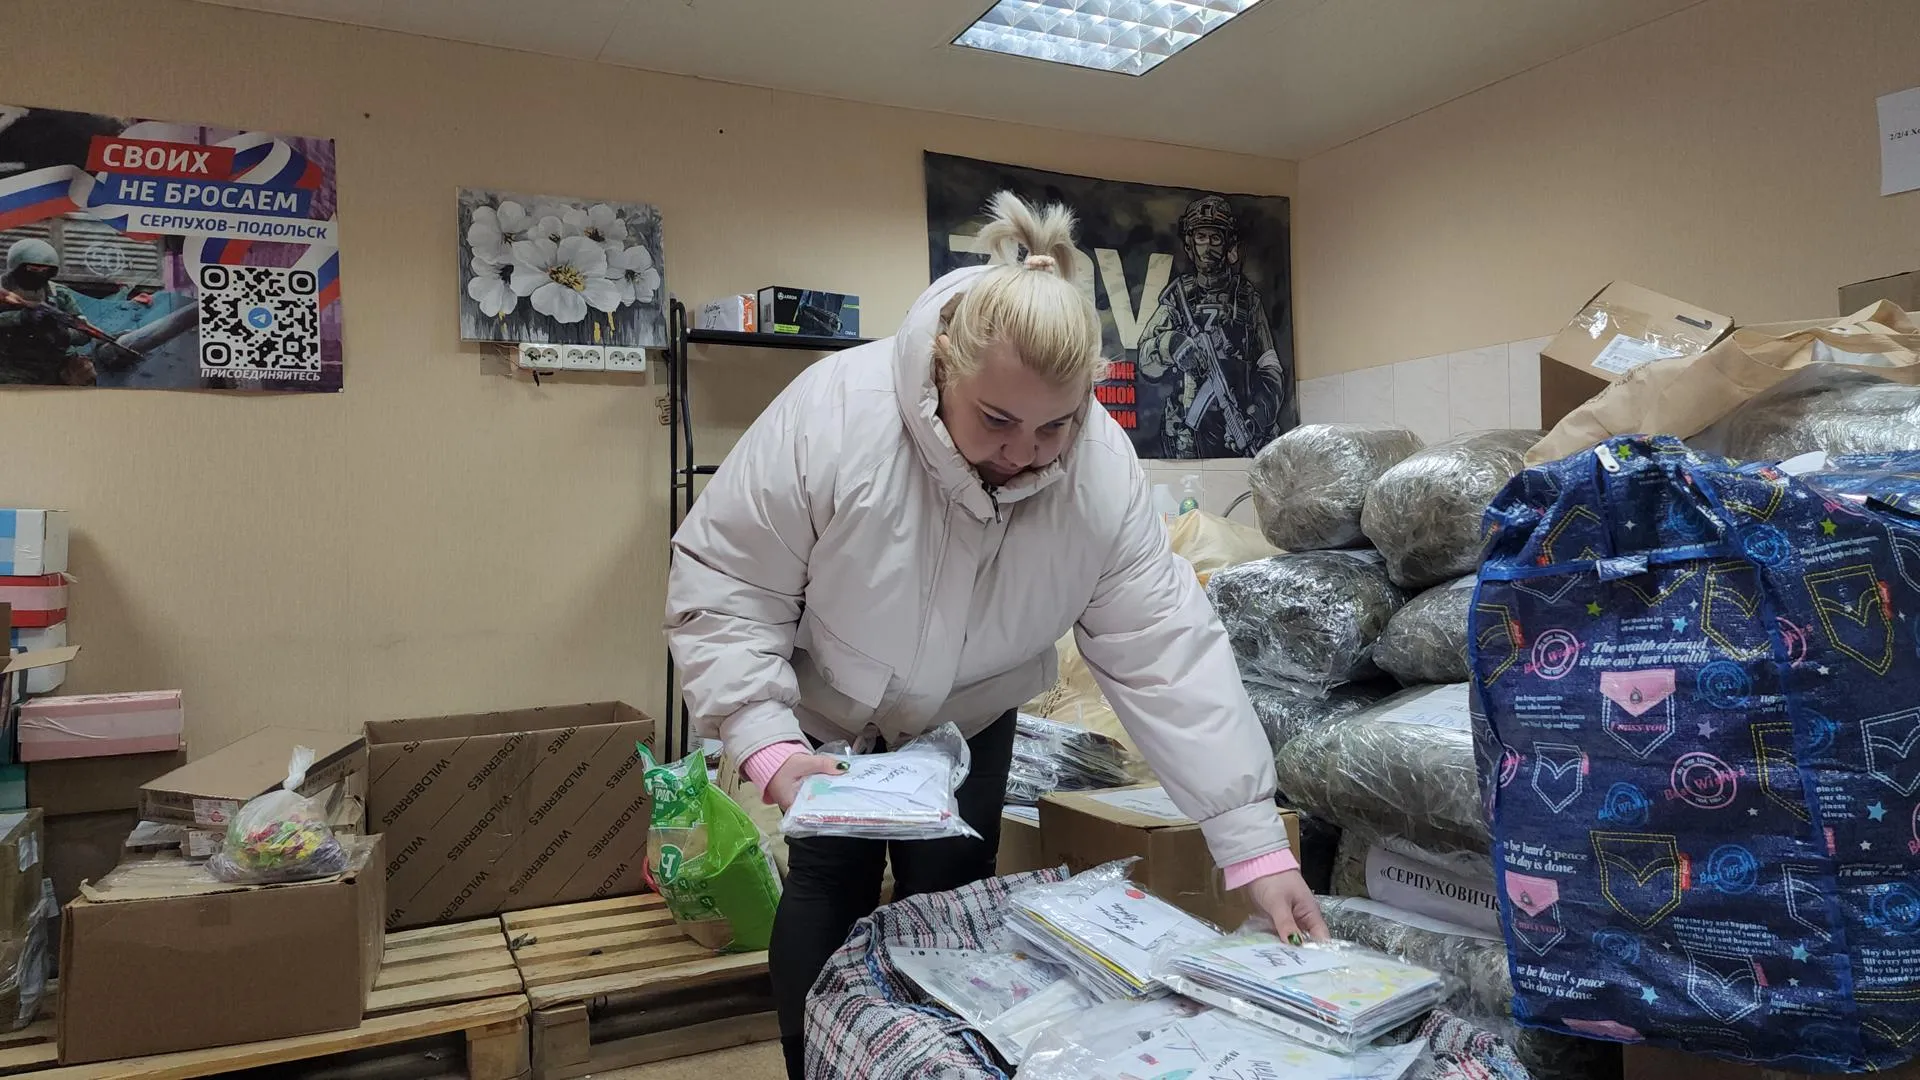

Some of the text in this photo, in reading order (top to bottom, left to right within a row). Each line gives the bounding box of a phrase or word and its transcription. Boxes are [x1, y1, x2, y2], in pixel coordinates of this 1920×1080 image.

[102, 143, 211, 174] СВОИХ
[118, 179, 298, 213] НЕ БРОСАЕМ
[140, 213, 328, 239] СЕРПУХОВ-ПОДОЛЬСК
[1591, 641, 1617, 653] The
[1618, 639, 1656, 653] wealth
[1579, 656, 1590, 666] is
[1590, 654, 1612, 666] the
[1612, 653, 1637, 669] only
[382, 758, 451, 826] WILDBERRIES
[528, 760, 591, 826] WILDBERRIES
[448, 793, 513, 862] WILDBERRIES
[586, 795, 648, 860] WILDBERRIES
[508, 828, 573, 896] WILDBERRIES
[1510, 840, 1521, 852] be
[1522, 841, 1552, 858] heart's
[1554, 850, 1588, 861] peace
[1517, 855, 1533, 870] day
[1533, 858, 1543, 870] is
[1861, 948, 1880, 957] May
[1898, 949, 1910, 957] joy
[1526, 965, 1538, 977] be
[1539, 967, 1576, 984] heart's
[1576, 977, 1606, 988] peace
[1864, 966, 1883, 974] May
[1900, 966, 1913, 974] joy
[1536, 980, 1554, 996] day
[1556, 985, 1565, 997] is
